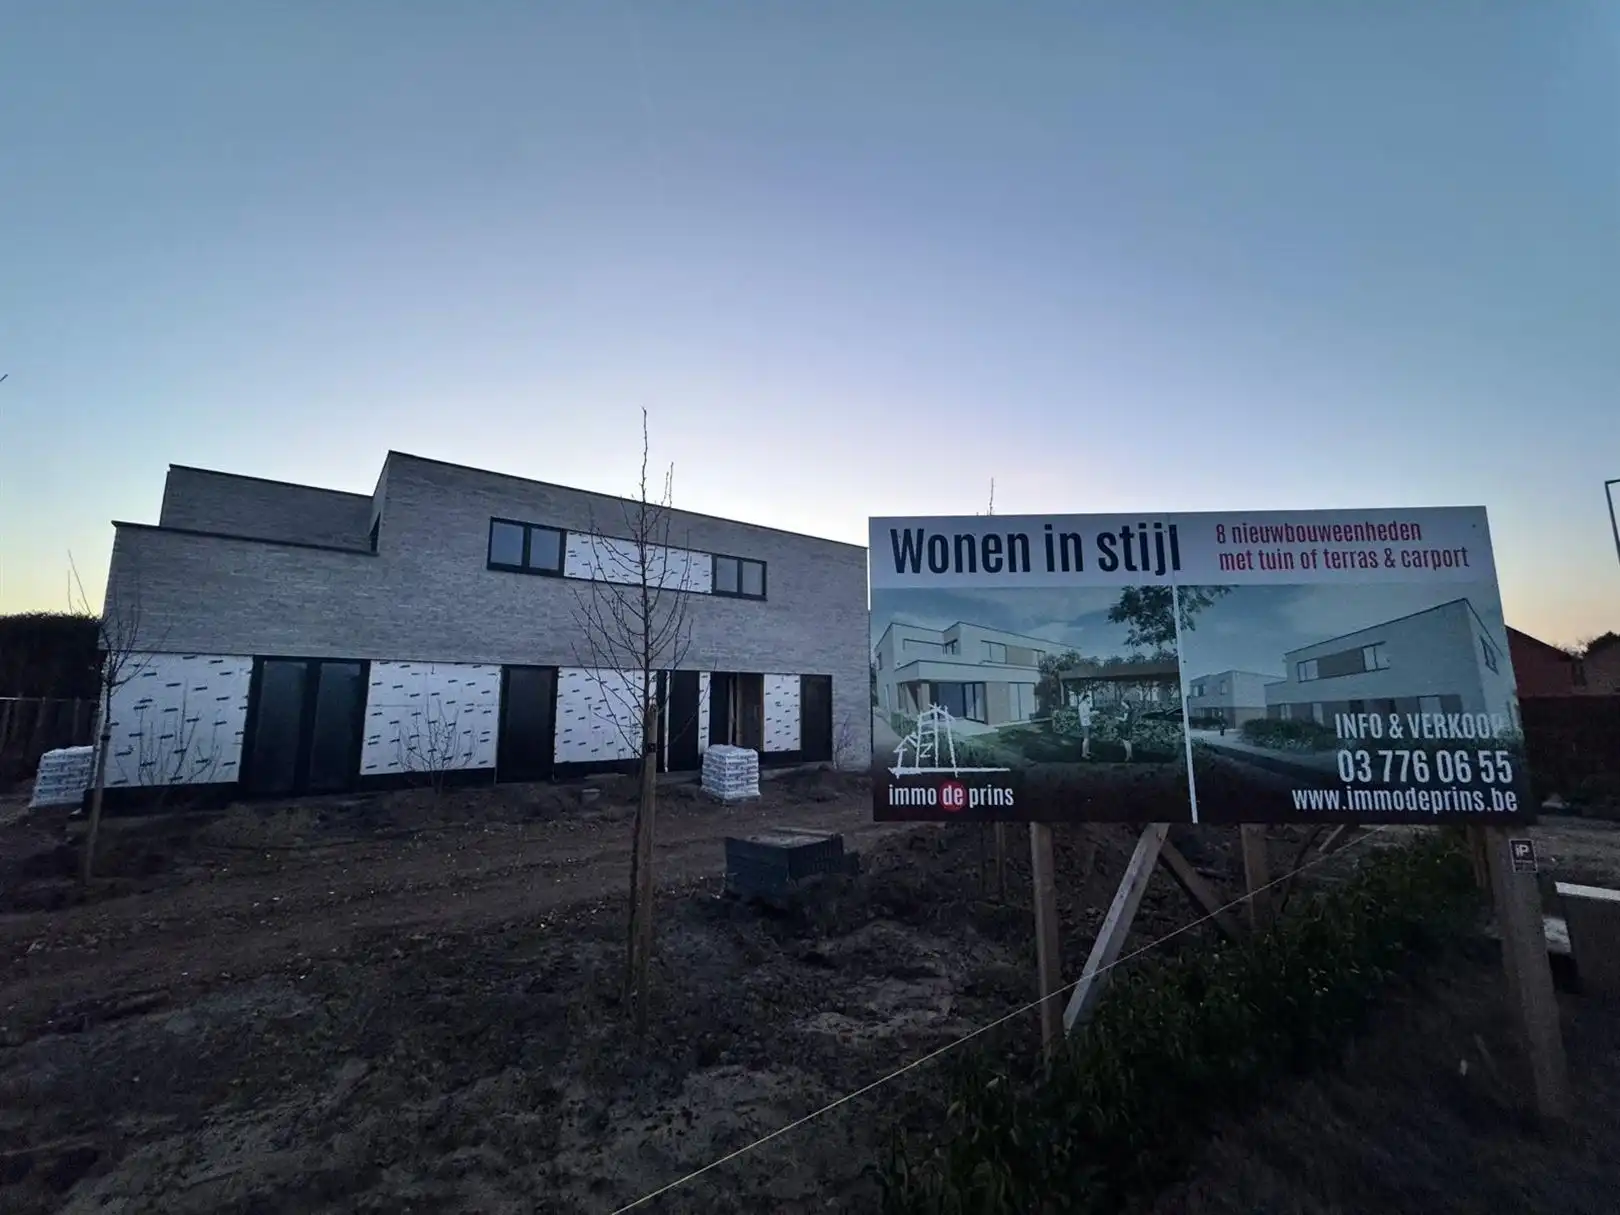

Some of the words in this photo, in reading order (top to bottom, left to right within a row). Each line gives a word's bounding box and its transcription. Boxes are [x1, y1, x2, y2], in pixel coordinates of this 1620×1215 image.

[1216, 523, 1226, 544] 8
[1232, 521, 1422, 544] nieuwbouweenheden
[890, 528, 1030, 574] Wonen
[1044, 523, 1084, 573] in
[1096, 522, 1181, 576] stijl
[1219, 550, 1254, 571] met
[1258, 548, 1295, 570] tuin
[1300, 548, 1319, 570] of
[1323, 548, 1379, 569] terras
[1384, 547, 1396, 569] &
[1401, 546, 1470, 571] carport
[1335, 712, 1383, 739] INFO
[1389, 713, 1403, 739] &
[1406, 712, 1504, 740] VERKOOP
[1337, 750, 1372, 783] 03
[1378, 750, 1430, 783] 776
[1436, 750, 1472, 783] 06
[1478, 750, 1513, 783] 55
[888, 784, 937, 806] immo
[942, 784, 963, 806] de
[968, 784, 1014, 809] prins
[1292, 786, 1518, 814] www.immodeprins.be
